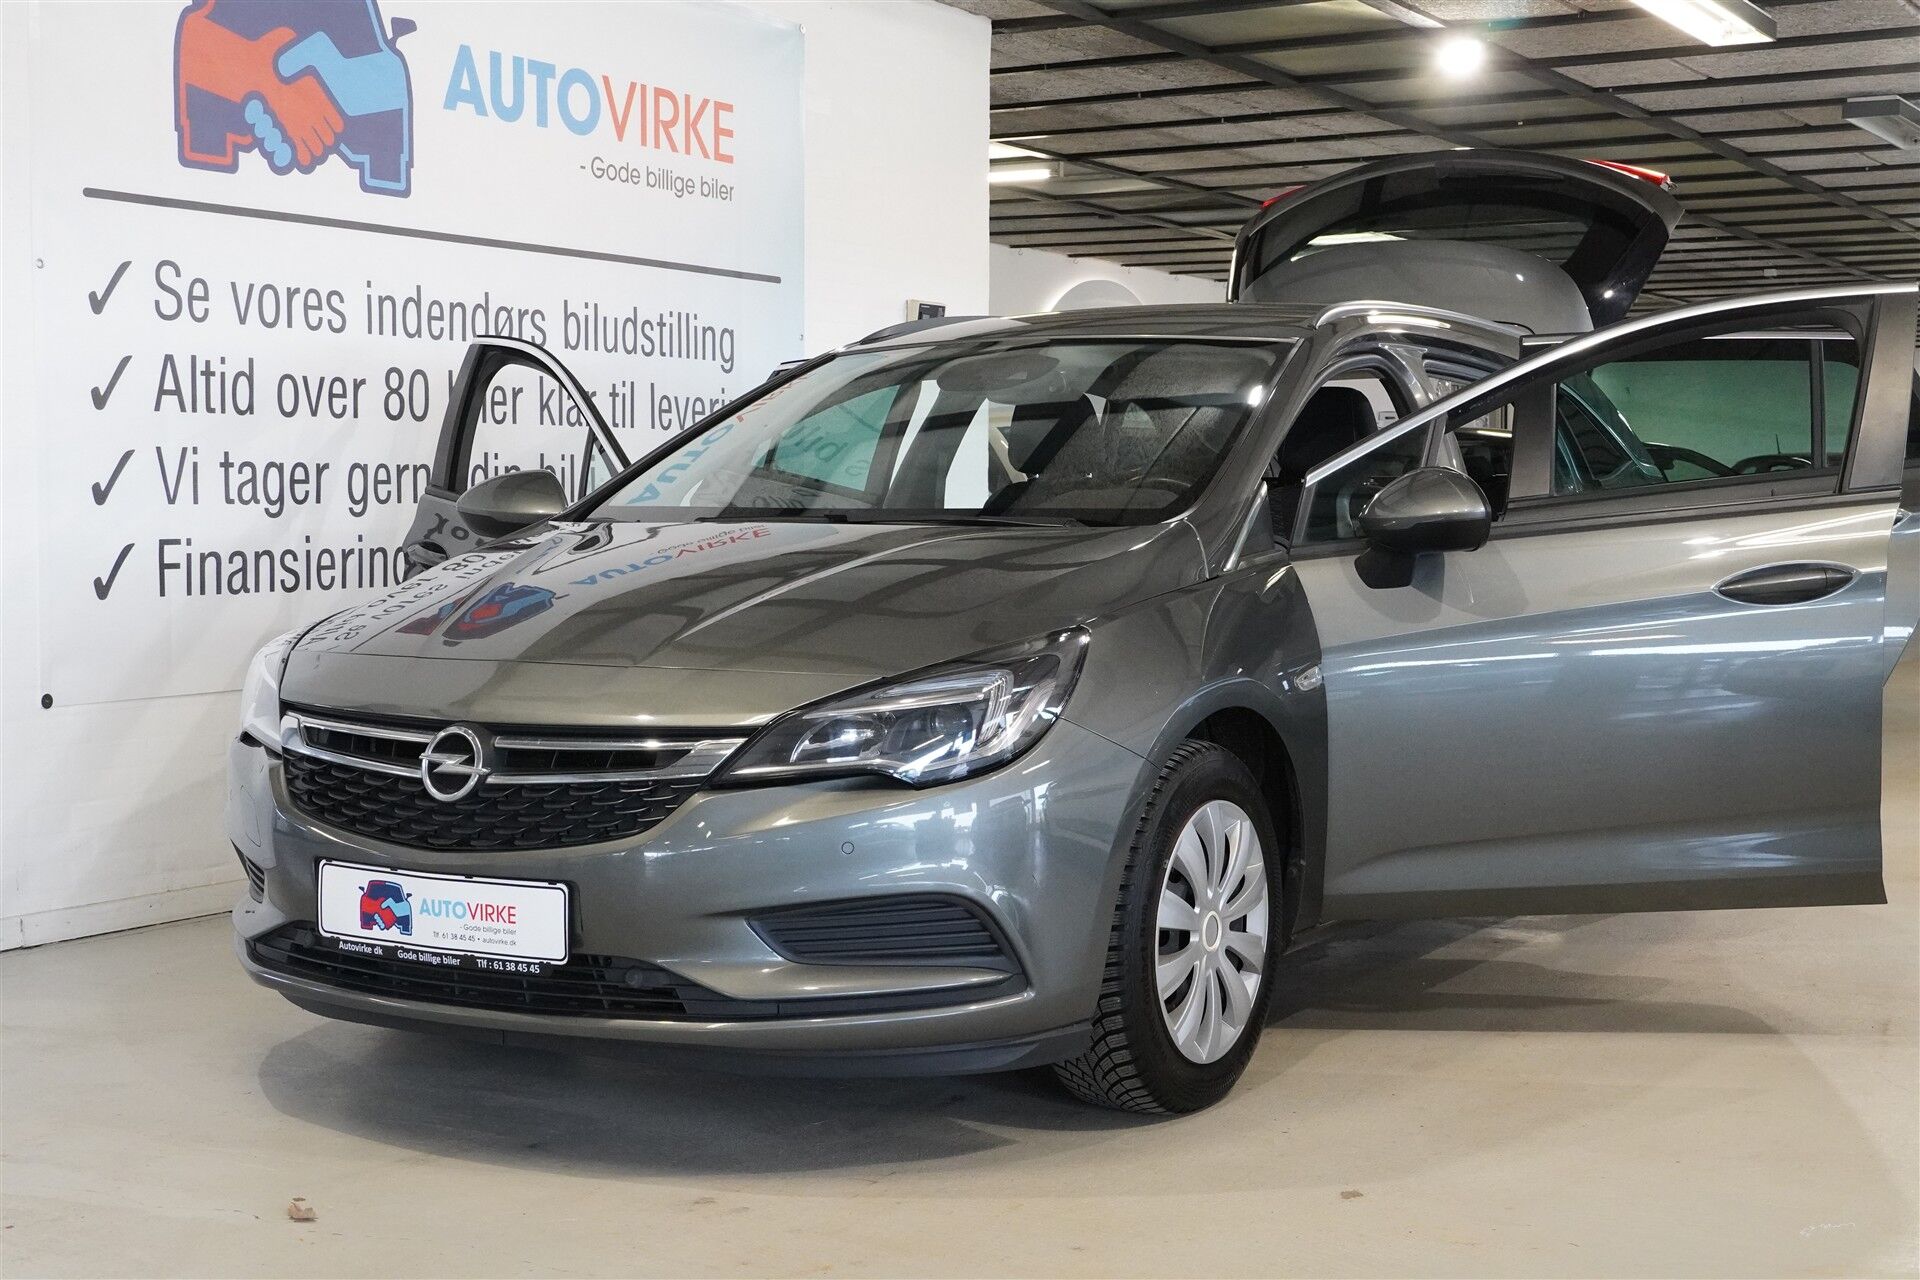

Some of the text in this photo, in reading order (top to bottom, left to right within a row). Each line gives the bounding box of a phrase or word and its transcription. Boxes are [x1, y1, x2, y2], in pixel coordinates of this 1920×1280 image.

[443, 44, 734, 164] AUTOVIRKE
[591, 156, 641, 185] Gode
[646, 165, 695, 198] billige
[700, 176, 734, 202] biler
[154, 259, 735, 374] Se vores indendørs biludstilling
[154, 354, 255, 416] Altid
[276, 373, 366, 420] over
[383, 367, 430, 422] 80
[609, 381, 635, 428] til
[155, 446, 199, 505] Vi
[219, 451, 329, 519] tager
[347, 461, 432, 518] gern
[419, 898, 517, 924] AUTOVIRKE
[463, 924, 481, 932] Gode
[482, 925, 501, 935] billige
[339, 941, 373, 954] Autovirke
[398, 949, 418, 960] Gode
[419, 952, 441, 965] billige
[442, 955, 460, 966] biler
[493, 961, 503, 970] 61
[506, 962, 516, 971] 38
[517, 963, 528, 973] 45
[529, 964, 540, 974] 45
[442, 932, 449, 940] 61
[468, 935, 476, 943] 45
